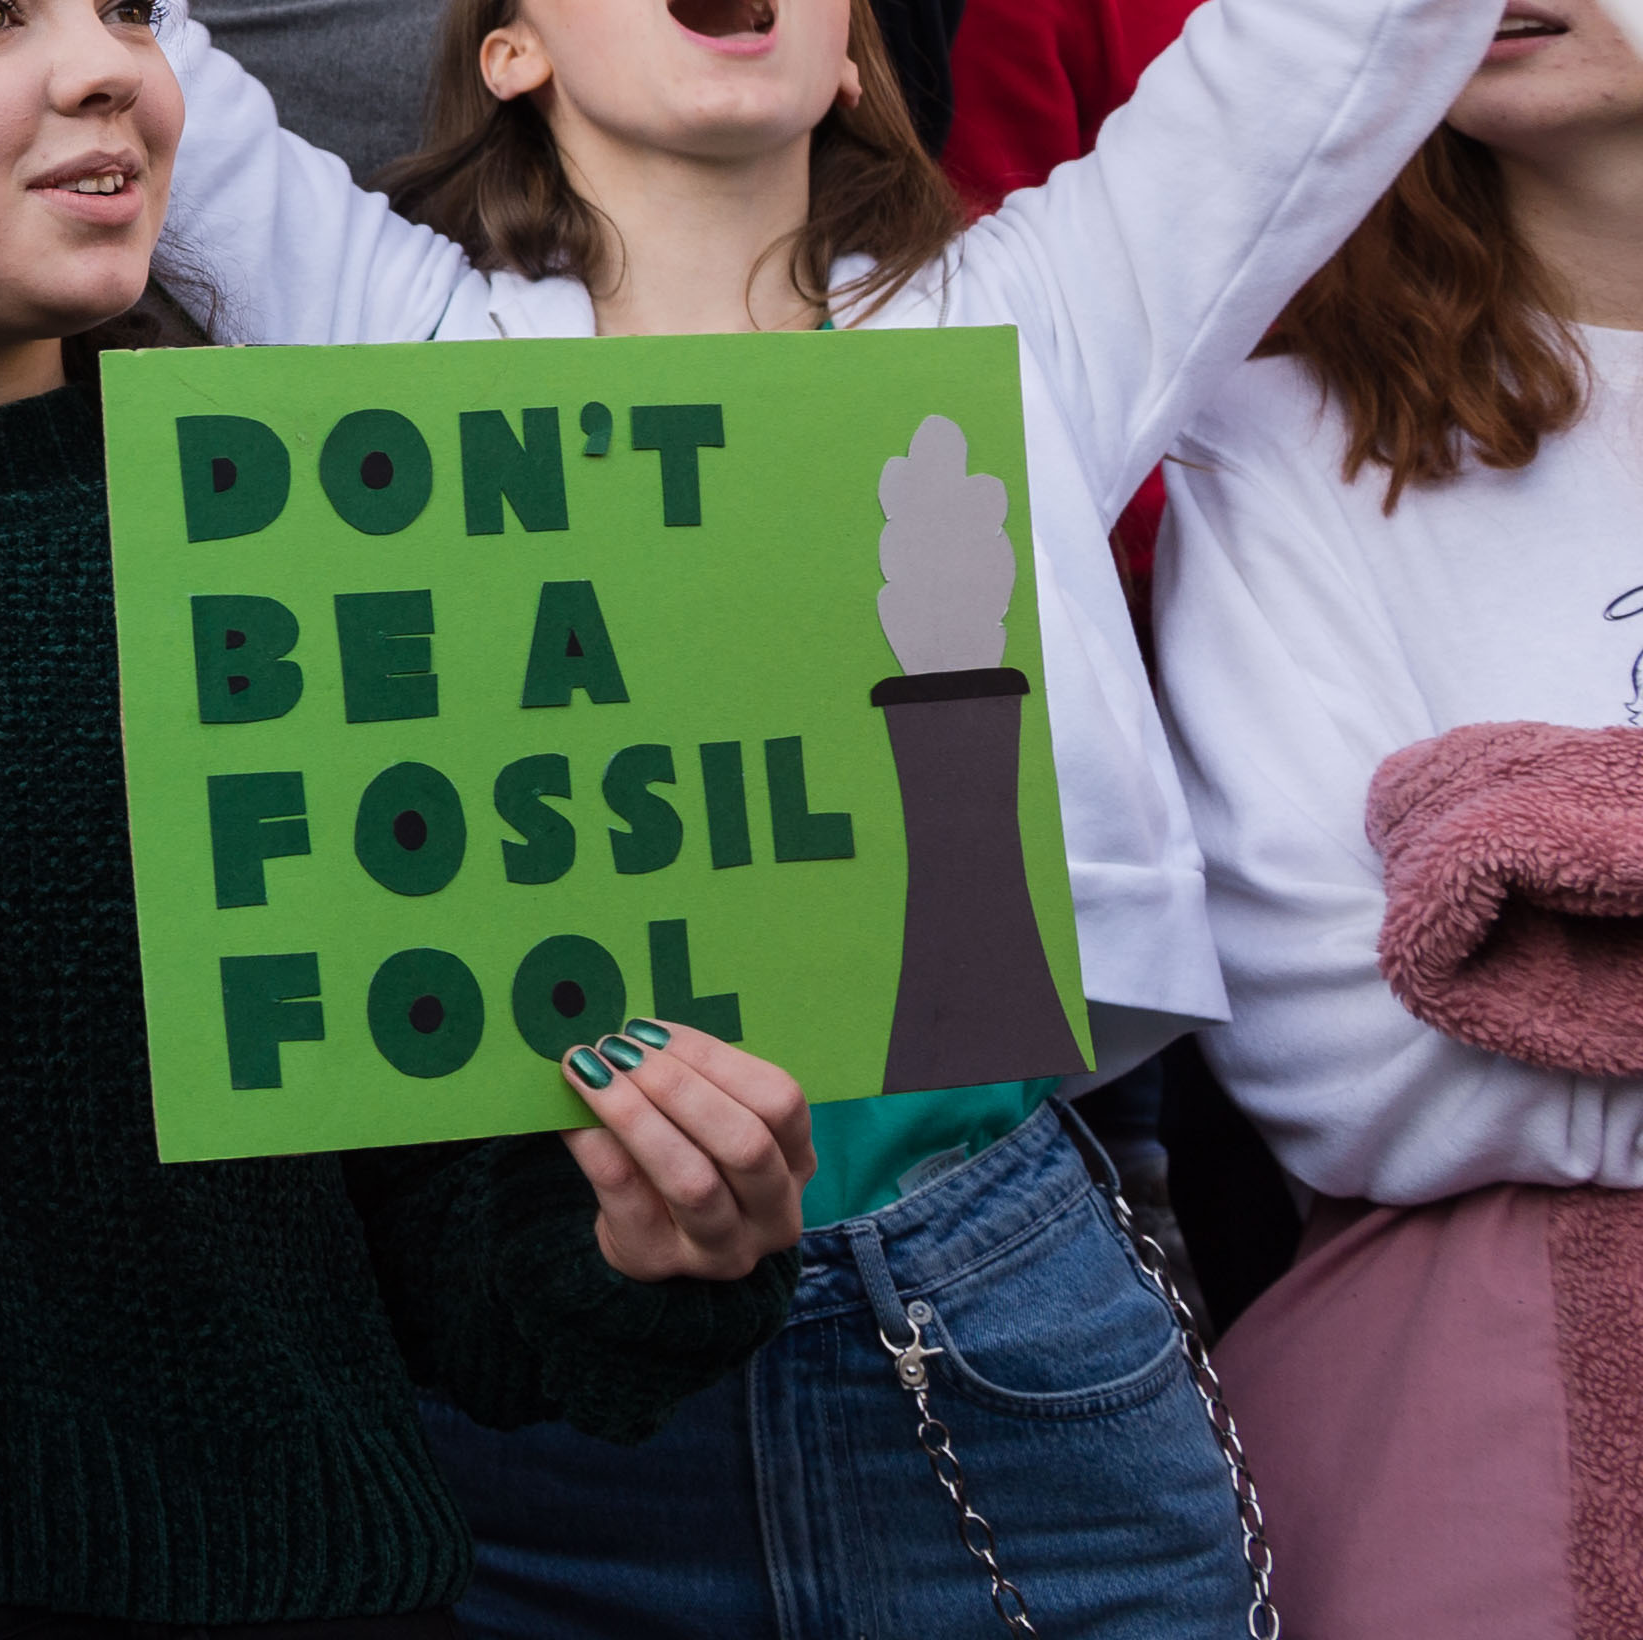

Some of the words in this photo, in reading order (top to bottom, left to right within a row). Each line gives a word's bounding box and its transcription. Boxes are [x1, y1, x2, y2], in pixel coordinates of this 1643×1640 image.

[175, 400, 727, 543] DON'T
[189, 588, 440, 725] BE
[520, 579, 631, 709] A
[205, 734, 857, 910] FOSSIL
[218, 917, 745, 1091] FOOL
